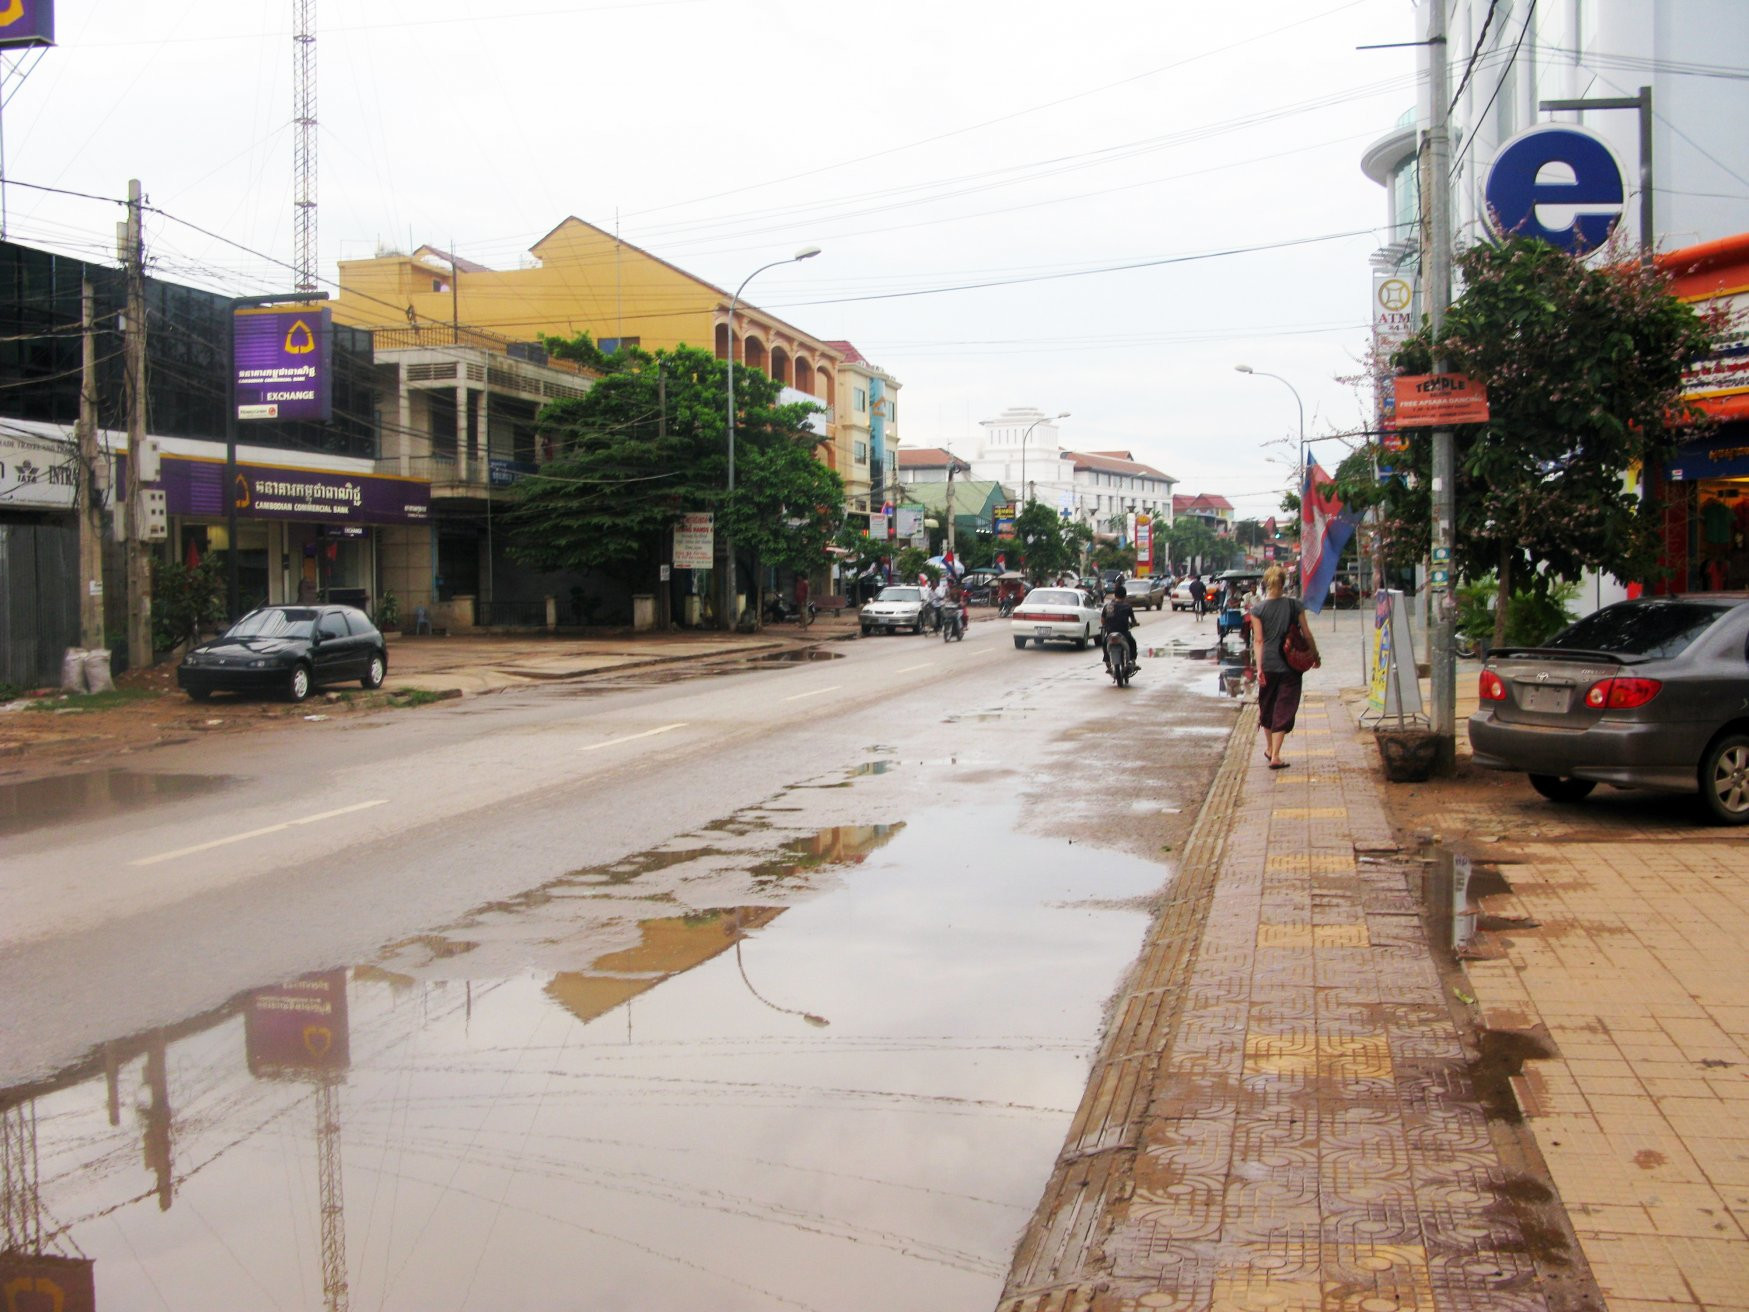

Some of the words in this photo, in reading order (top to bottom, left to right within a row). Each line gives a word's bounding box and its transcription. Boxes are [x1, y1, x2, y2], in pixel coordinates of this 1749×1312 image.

[1379, 313, 1411, 324] ATM
[1416, 377, 1465, 392] TEMPLE
[266, 390, 316, 401] EXCHANGE
[255, 500, 293, 512] CAMBODIAN
[294, 502, 333, 514] COMMERCIAL
[333, 505, 350, 515] BANK
